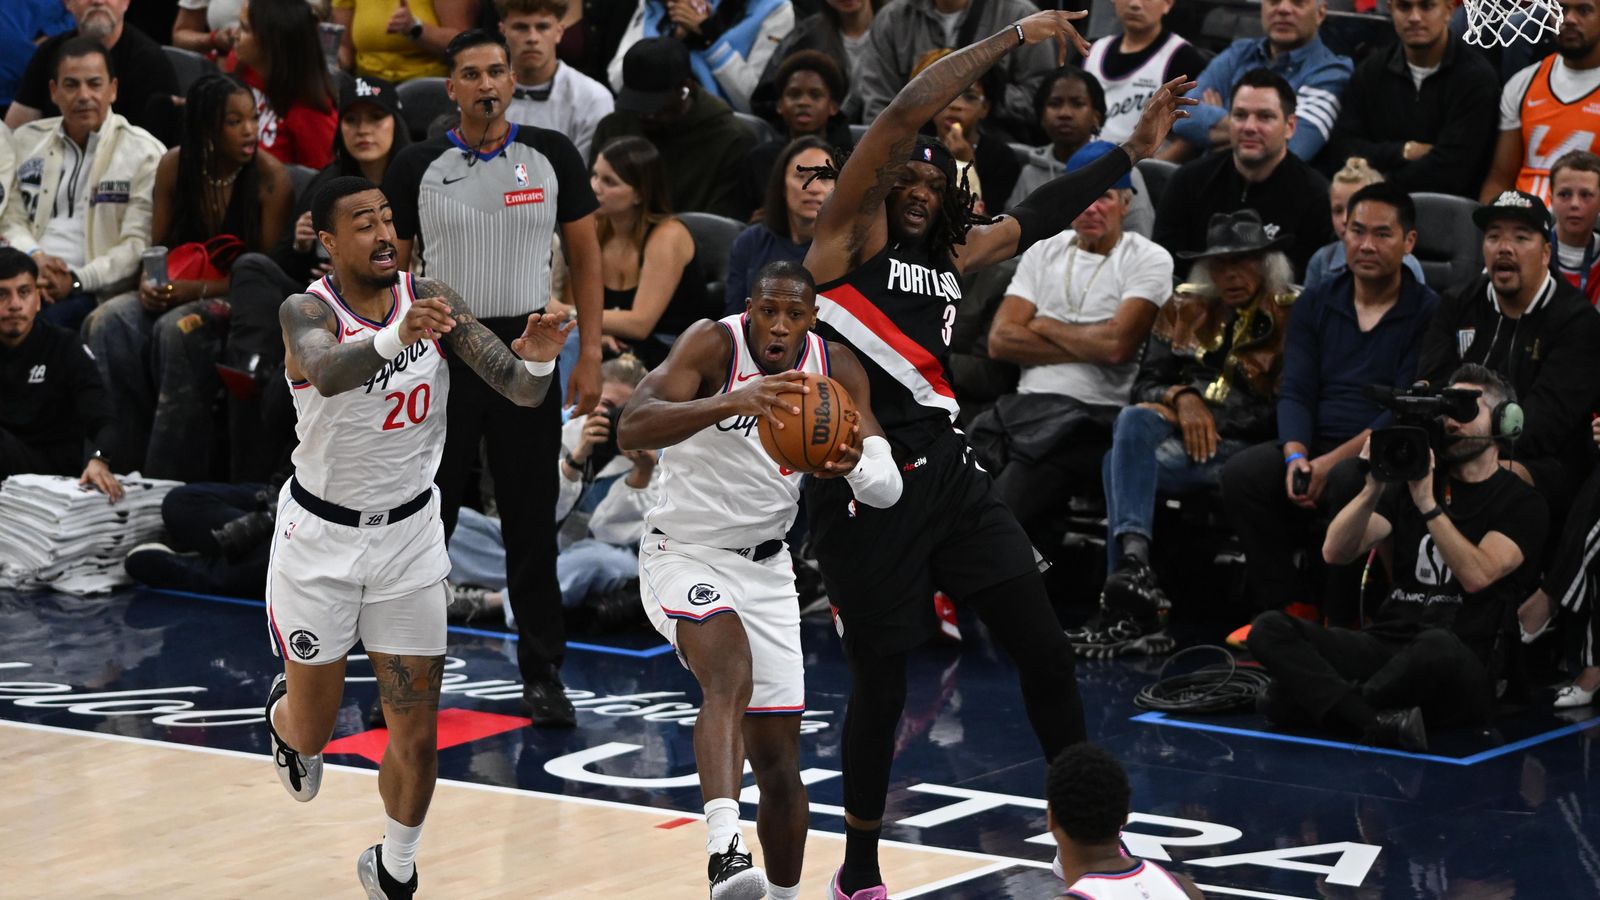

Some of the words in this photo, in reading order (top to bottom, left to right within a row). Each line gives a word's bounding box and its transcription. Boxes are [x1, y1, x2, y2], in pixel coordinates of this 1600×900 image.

[355, 78, 371, 96] LA
[505, 192, 544, 204] Emirates
[887, 257, 962, 302] PORTLND
[941, 304, 957, 347] 3
[382, 383, 431, 431] 20
[811, 382, 831, 446] Wilson
[365, 514, 384, 525] LA
